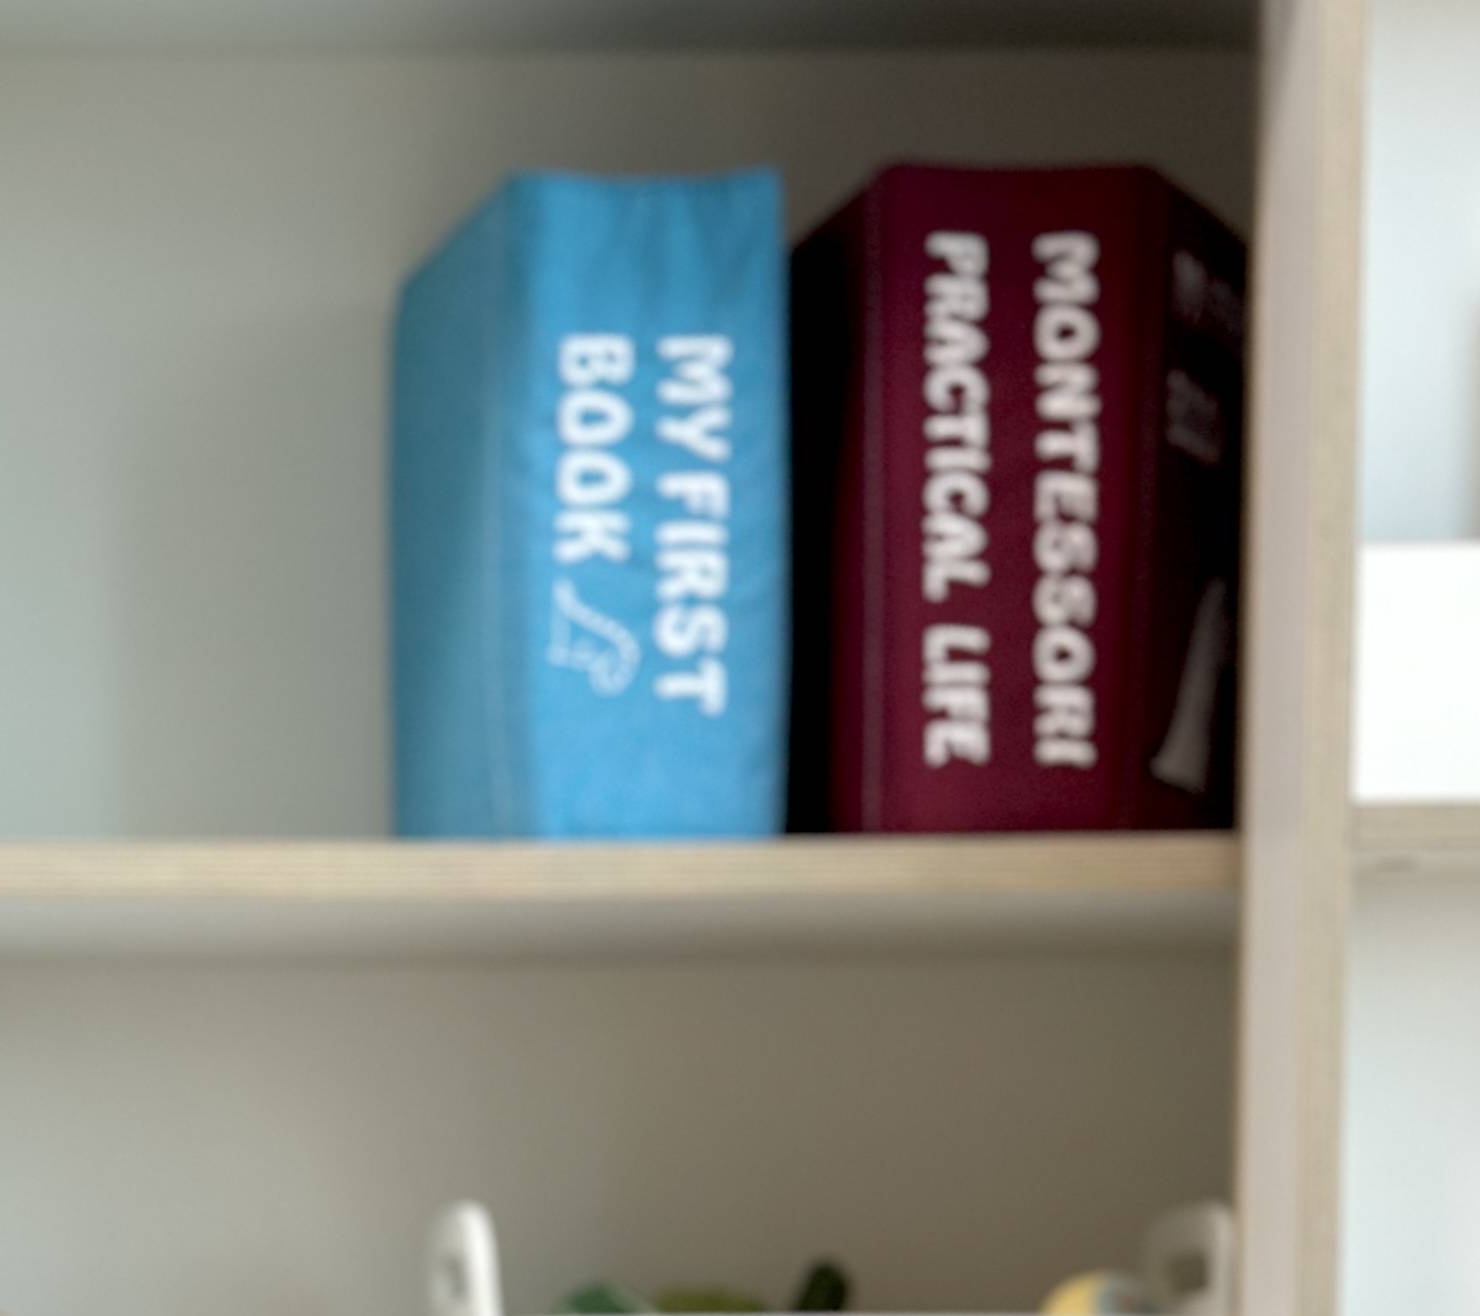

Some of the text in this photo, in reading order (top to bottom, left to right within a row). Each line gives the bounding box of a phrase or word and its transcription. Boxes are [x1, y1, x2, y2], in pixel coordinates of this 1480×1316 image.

[553, 332, 634, 563] BOOK
[653, 335, 733, 717] MY FIRST
[923, 230, 991, 768] PRACTICAL LIFE
[1032, 230, 1101, 770] MONTESSORI
